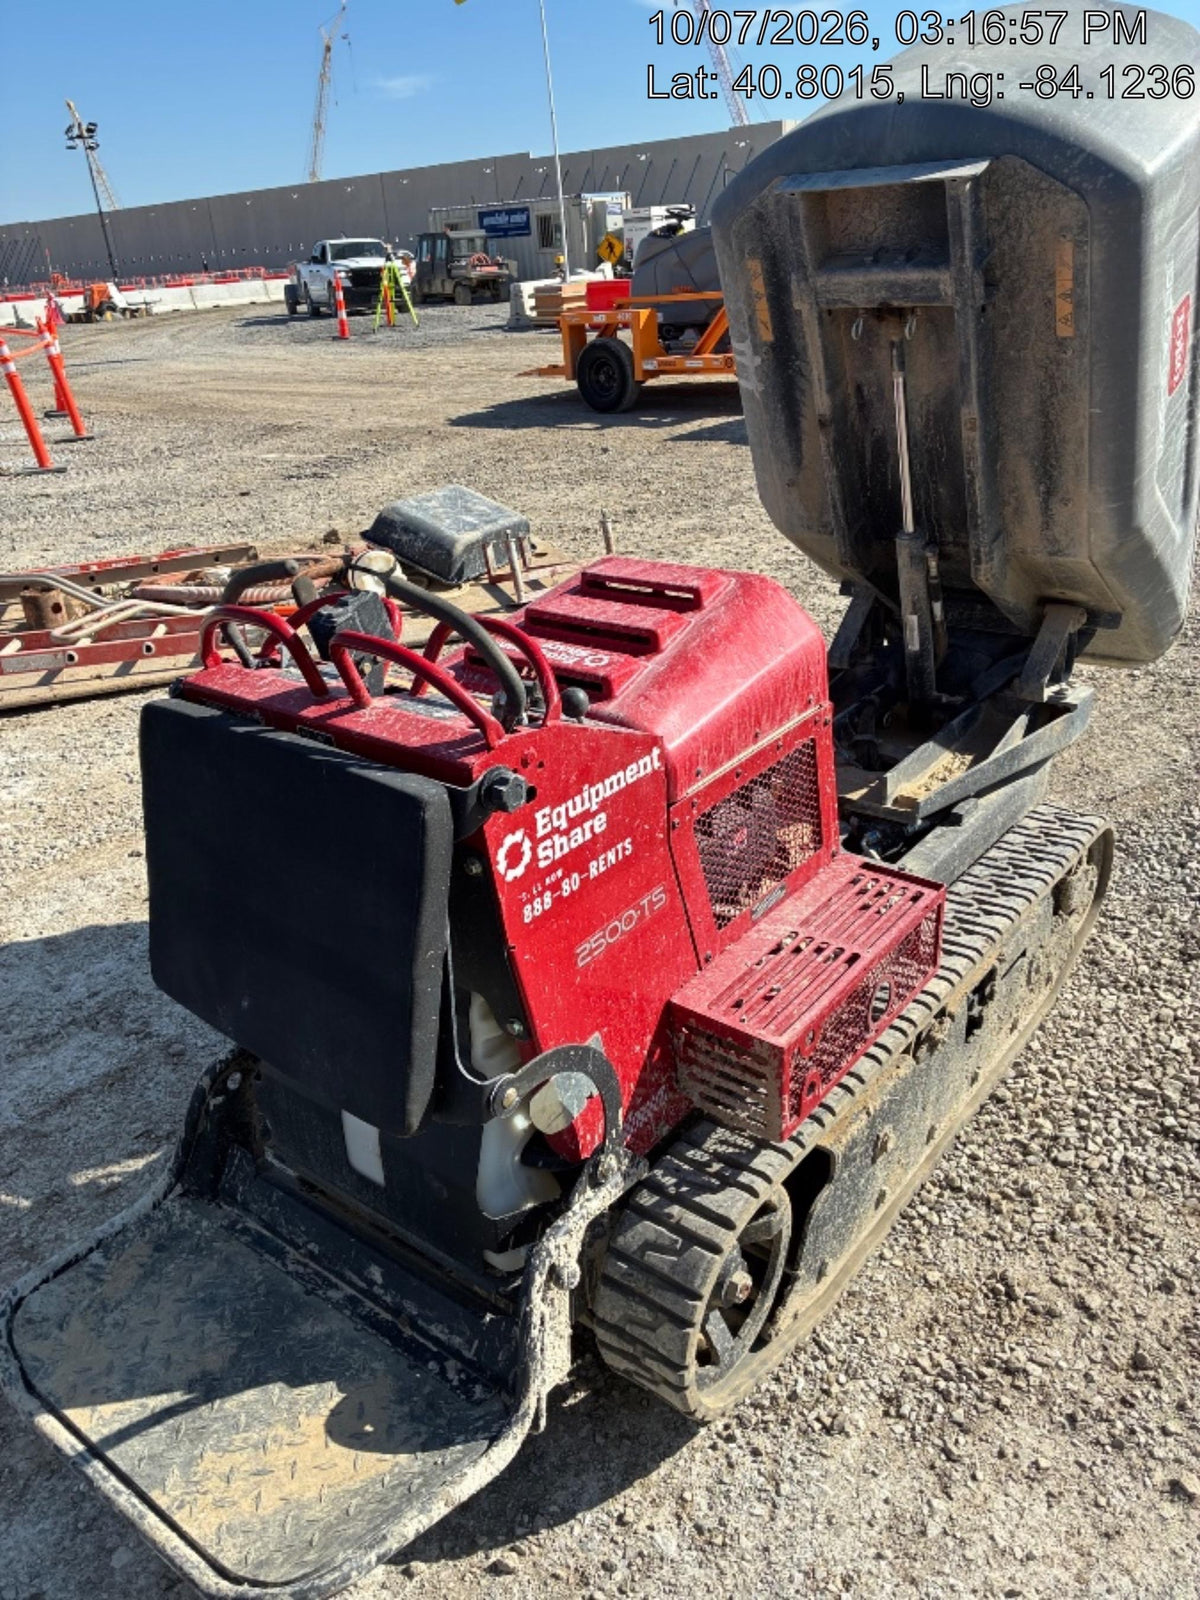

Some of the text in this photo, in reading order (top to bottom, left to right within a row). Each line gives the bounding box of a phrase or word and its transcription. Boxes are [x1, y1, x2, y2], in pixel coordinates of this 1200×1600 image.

[535, 746, 661, 838] Equipment
[523, 838, 633, 924] 888-80-RENTS
[537, 811, 608, 869] Share
